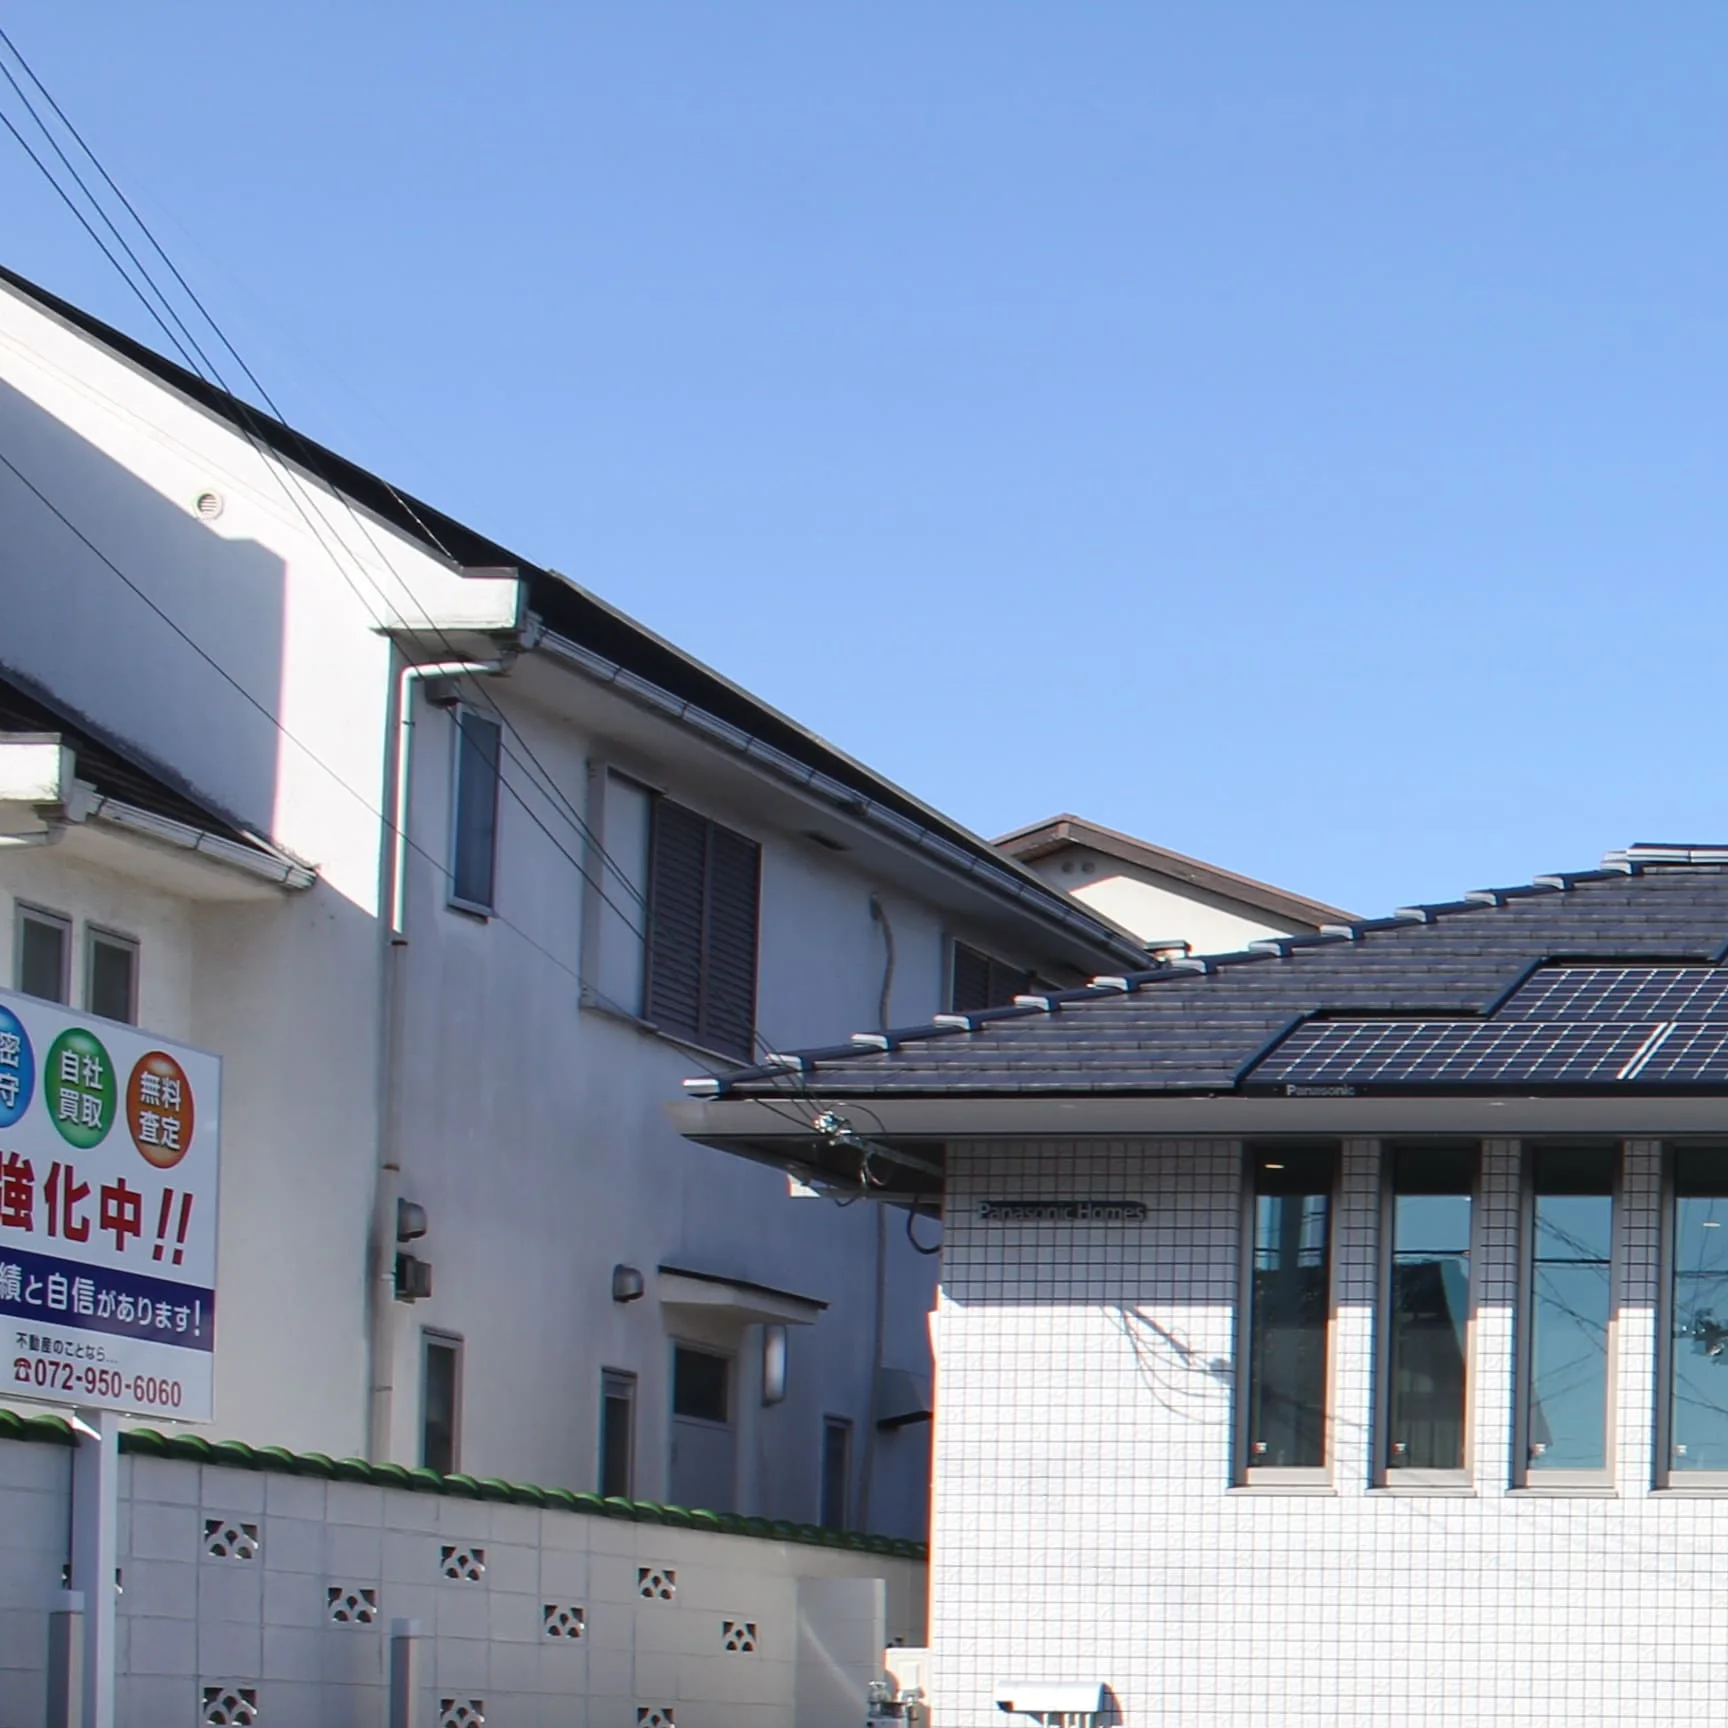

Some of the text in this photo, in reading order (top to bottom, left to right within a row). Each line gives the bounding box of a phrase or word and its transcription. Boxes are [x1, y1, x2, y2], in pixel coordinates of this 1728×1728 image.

[60, 1050, 103, 1090] 自社
[59, 1087, 102, 1129] 買取
[140, 1071, 181, 1112] 無料
[139, 1110, 181, 1150] 査定
[979, 1203, 1144, 1220] Panasonic Homes
[35, 1358, 181, 1407] 072-950-6060
